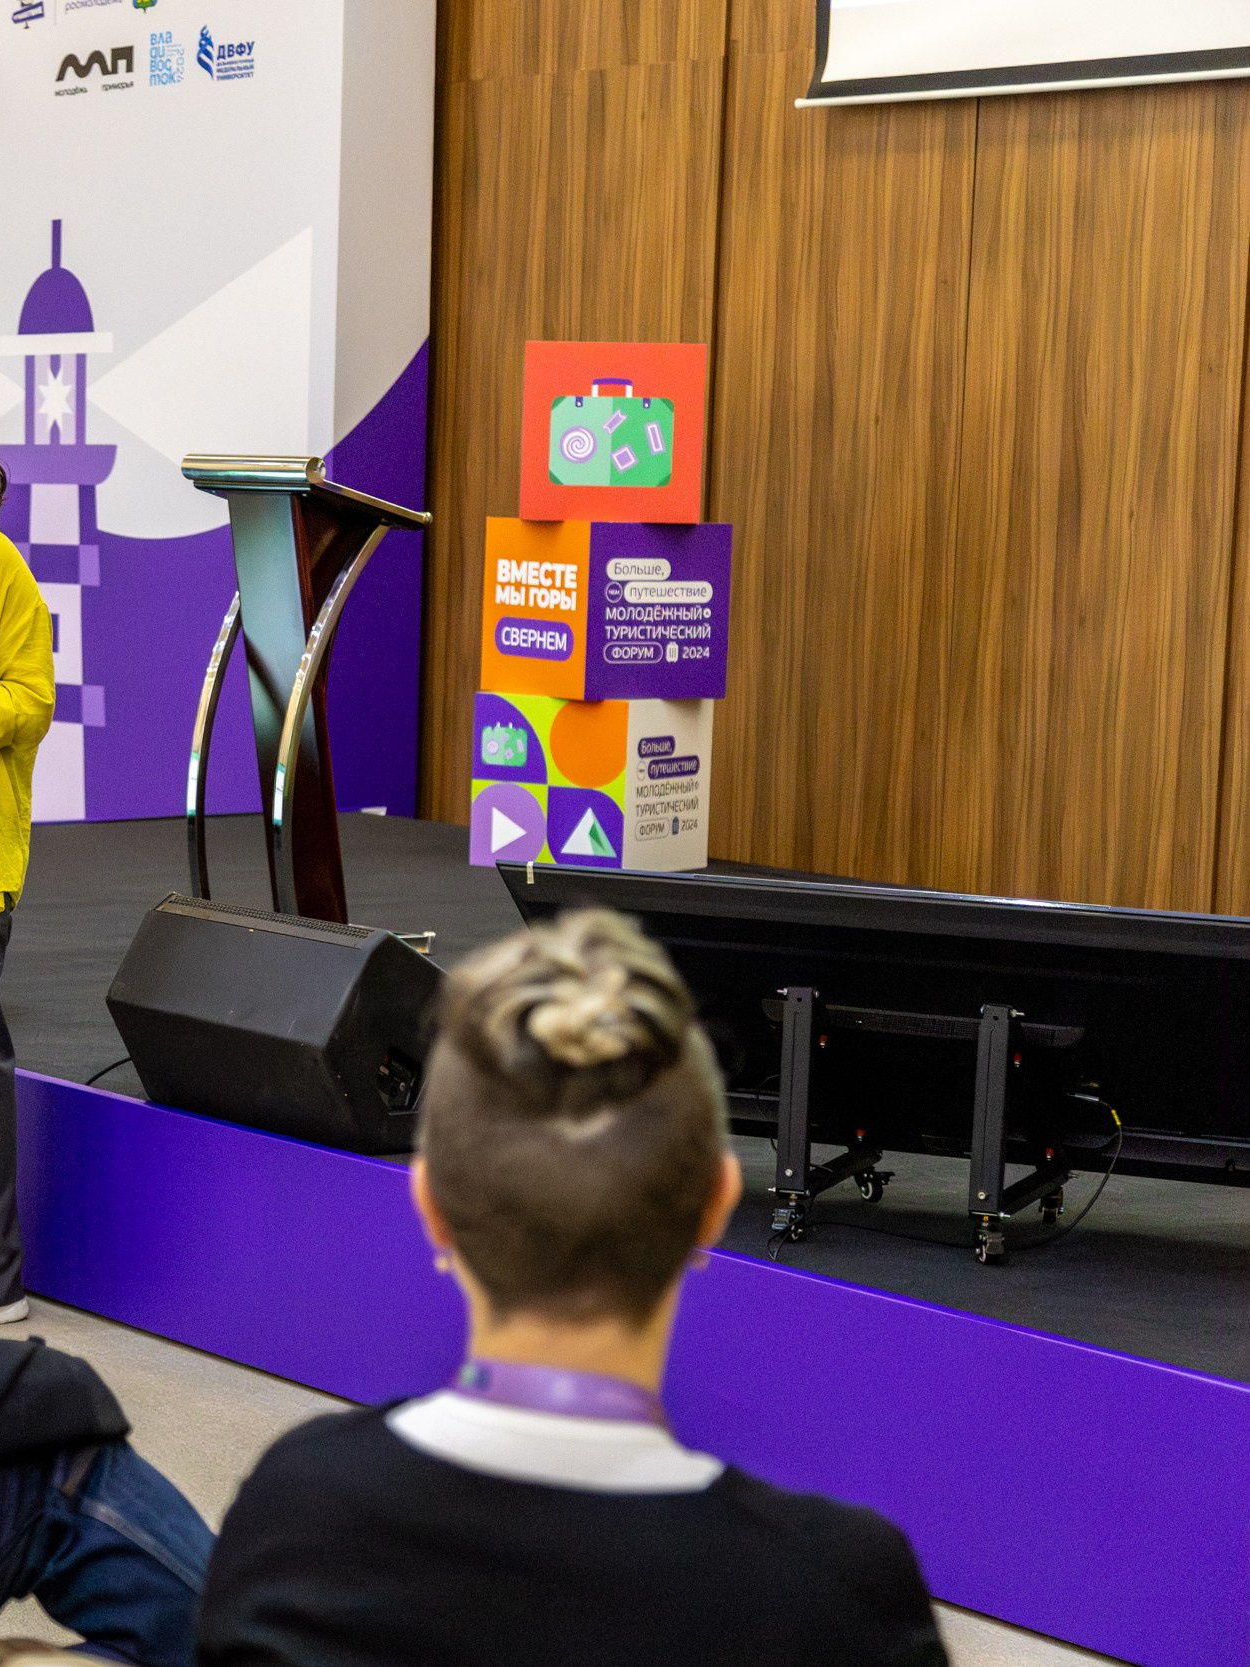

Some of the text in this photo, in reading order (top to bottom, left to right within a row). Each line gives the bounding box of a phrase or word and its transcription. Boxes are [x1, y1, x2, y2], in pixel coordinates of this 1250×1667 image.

[216, 41, 255, 60] ДВФУ
[497, 558, 578, 589] ВМЕСТЕ
[614, 562, 665, 577] Больше,
[495, 584, 577, 611] МЫ ГОРЫ
[630, 587, 708, 600] путешествие
[605, 605, 703, 623] МОЛОДЁЖНЫЙ
[501, 626, 567, 652] СВЕРНЕМ
[605, 623, 711, 640] ТУРИСТИЧЕСКИЙ
[612, 646, 710, 659] ФОРУМ 2024
[641, 741, 673, 754] Больше,
[650, 760, 698, 778] путешествие
[636, 796, 699, 817] ТУРИСТИЧЕСКИЙ
[639, 819, 698, 836] ФОРУМ 2024
